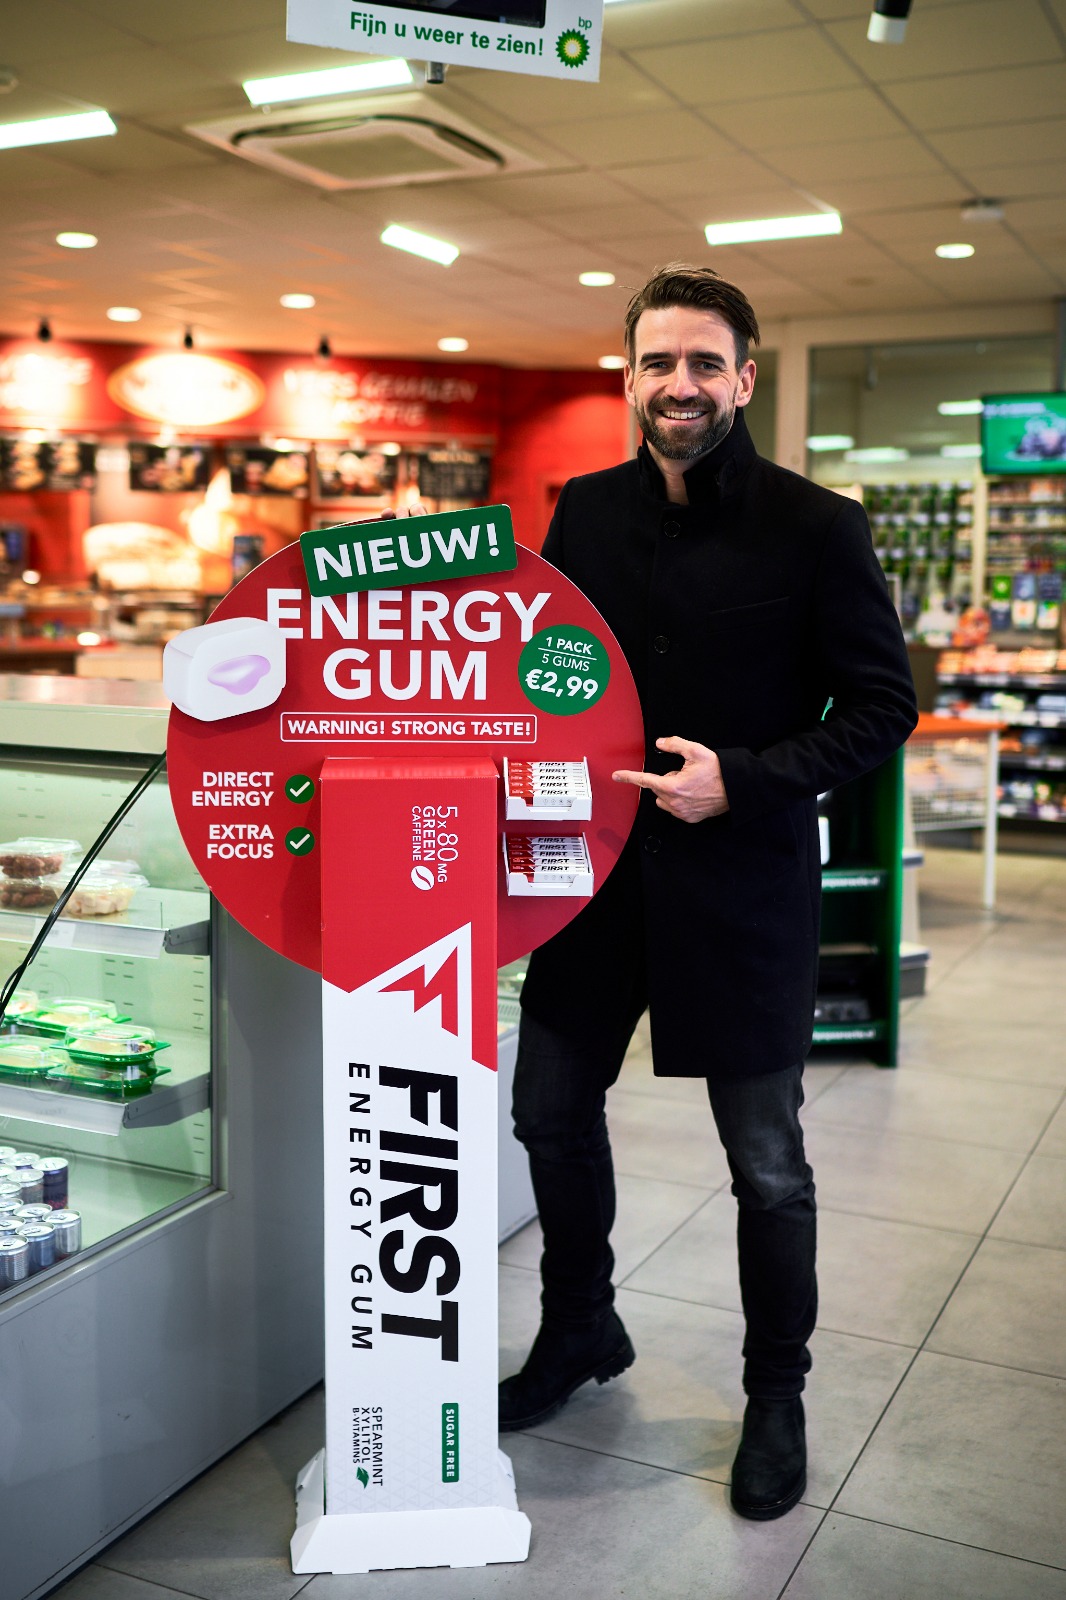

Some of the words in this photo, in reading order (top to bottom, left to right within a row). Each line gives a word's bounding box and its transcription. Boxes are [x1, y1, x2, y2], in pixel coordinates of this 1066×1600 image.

[350, 11, 387, 37] Fijn
[394, 25, 406, 38] u
[414, 26, 463, 45] weer
[470, 31, 490, 49] te
[497, 34, 544, 56] zien!
[578, 16, 592, 30] bp
[313, 522, 501, 582] NIEUW!
[266, 588, 552, 643] ENERGY
[541, 653, 550, 664] 5
[552, 656, 590, 672] GUMS
[546, 636, 553, 647] 1
[556, 638, 593, 655] PACK
[322, 647, 488, 701] GUM
[525, 668, 599, 700] €2,99
[287, 720, 386, 736] WARNING!
[391, 720, 467, 736] STRONG
[470, 721, 532, 737] TASTE!
[191, 790, 275, 808] ENERGY
[203, 771, 274, 788] DIRECT
[207, 843, 274, 860] FOCUS
[208, 824, 274, 841] EXTRA
[411, 805, 422, 861] CAFFEINE
[422, 805, 436, 861] GREEN
[348, 1062, 372, 1239] ENERGY
[378, 1065, 461, 1363] FIRST
[350, 1263, 373, 1350] GUM
[361, 1407, 371, 1464] XYLITOL
[372, 1406, 383, 1487] SPEARMINT
[445, 1408, 455, 1446] SUGAR
[445, 1450, 455, 1477] FREE
